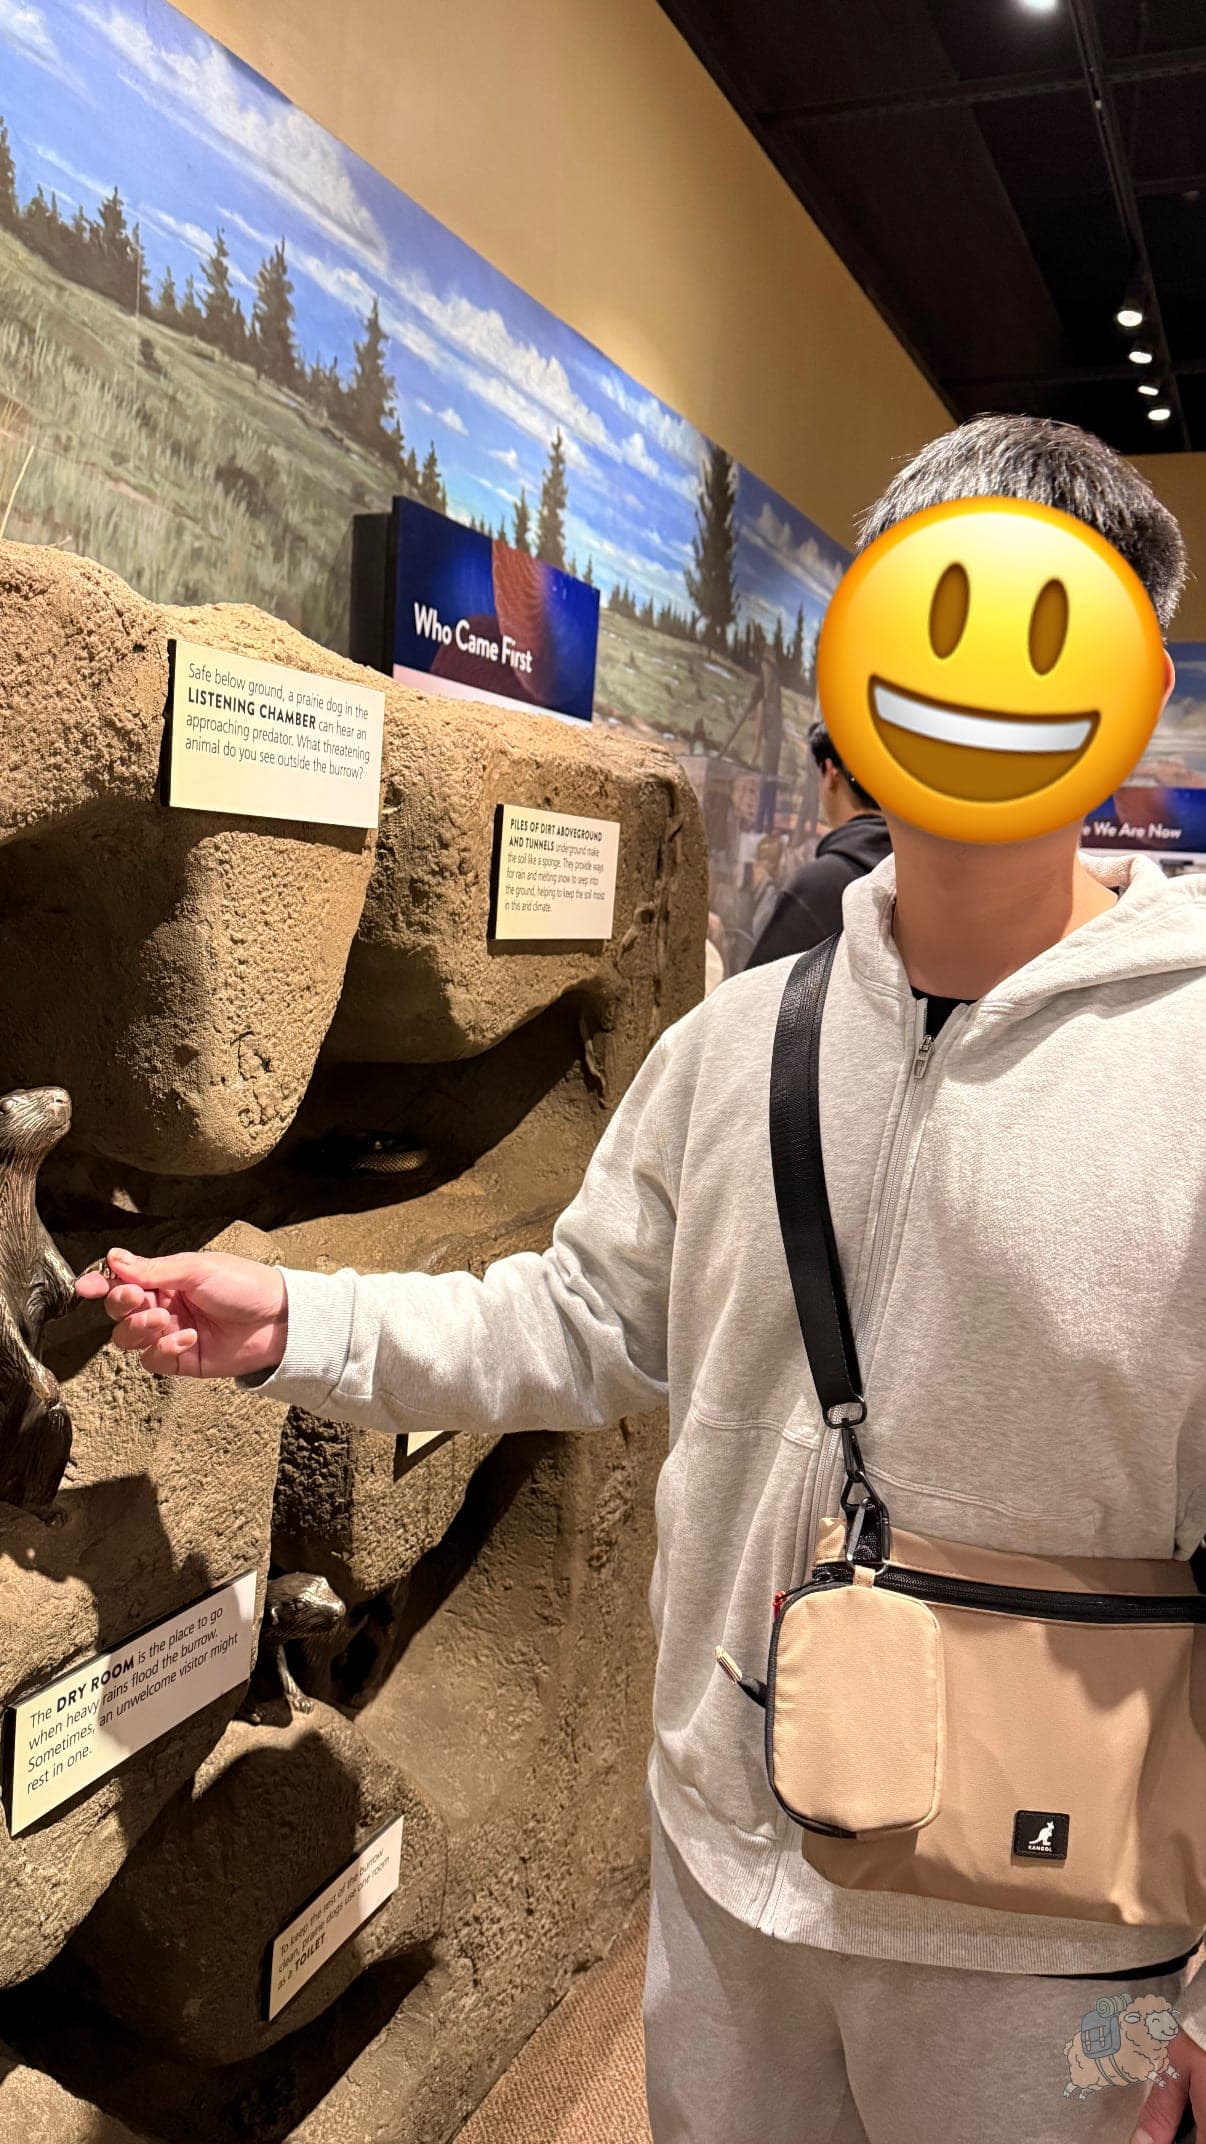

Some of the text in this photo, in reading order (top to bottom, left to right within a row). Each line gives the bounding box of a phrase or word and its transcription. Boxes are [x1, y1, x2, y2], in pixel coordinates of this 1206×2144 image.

[414, 602, 532, 673] Who Came First
[188, 687, 367, 740] LISTENING CHAMBER can hear an
[189, 663, 369, 719] Safe below ground, a prairie dog in the
[186, 714, 370, 764] approaching predator. What threatening
[186, 737, 363, 779] animal do you see outside the burrow?
[510, 818, 602, 842] PILES OF DIRT ABOVEGROUND
[510, 836, 599, 856] AND TUNNELS underground make
[1094, 821, 1116, 837] We
[1118, 822, 1145, 838] Are
[1148, 822, 1182, 839] Now
[508, 854, 604, 874] the soil like a sponge. They provide ways
[505, 901, 509, 911] in
[512, 901, 520, 910] this
[533, 901, 551, 912] climate.
[506, 884, 514, 894] the
[516, 886, 535, 897] ground,
[537, 887, 555, 899] helping
[557, 889, 562, 898] to
[563, 889, 574, 899] keep
[584, 889, 592, 898] soil
[593, 891, 605, 900] moist
[29, 1630, 218, 1750] when heavy rains flood the burrow.
[30, 1607, 223, 1728] The DRY ROOM is the place to go
[28, 1634, 238, 1772] Sometimes, an unwelcome visitor might
[27, 1749, 92, 1794] rest in one.
[279, 1857, 389, 1973] clean, prairie dogs use one room
[280, 1849, 384, 1956] To keep the rest of the burrow
[277, 1933, 326, 1990] as a TOILET
